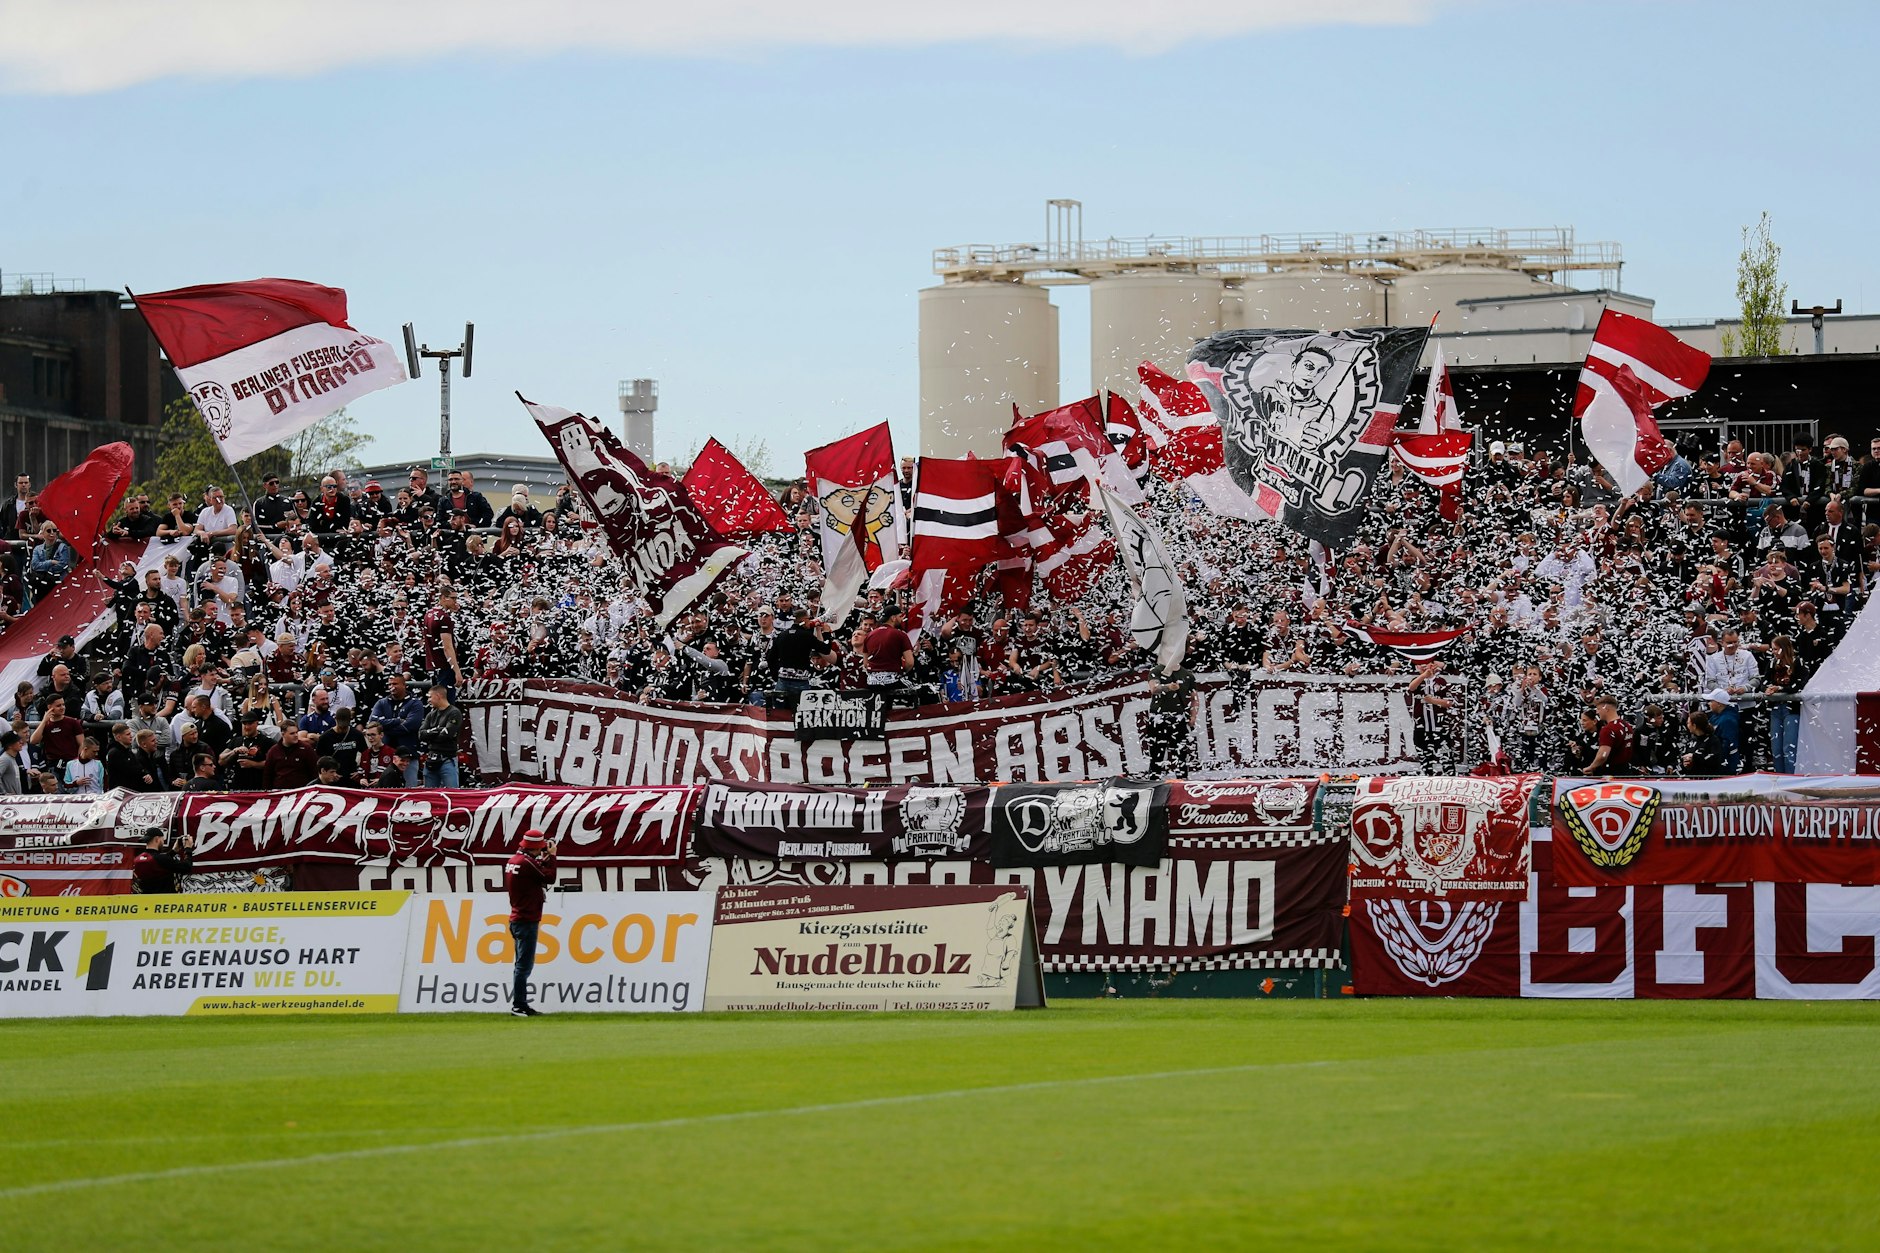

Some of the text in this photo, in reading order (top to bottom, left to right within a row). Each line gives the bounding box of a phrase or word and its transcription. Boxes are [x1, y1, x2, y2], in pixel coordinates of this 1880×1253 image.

[231, 362, 293, 400] BERLINER
[263, 349, 377, 415] DYNAMO
[795, 709, 882, 730] FRAKTION H
[0, 795, 58, 803] NAMO
[1570, 784, 1651, 810] BFC
[192, 790, 679, 855] BANDA INVICTA
[1178, 803, 1249, 825] Fanatico
[1661, 804, 1776, 840] TRADITION
[15, 835, 72, 848] BERLIN
[56, 852, 124, 864] MEISTER
[721, 889, 759, 898] Ab hier
[1352, 879, 1385, 888] BOCHUM
[1396, 879, 1426, 889] VELTEN
[154, 902, 228, 914] REPARATUR
[243, 901, 377, 912] BAUSTELLENSERVICE
[720, 911, 772, 920] Falkenberger
[830, 904, 855, 912] Berlin
[721, 902, 733, 910] 15
[734, 900, 775, 909] Minuten
[141, 926, 286, 946] WERKZEUGE,
[421, 899, 699, 964] Nascor
[798, 920, 929, 940] Kiezgaststätte
[137, 947, 361, 967] DIE GENAUSO HART
[750, 943, 972, 976] Nudelholz
[133, 971, 342, 990] ARBEITEN WIE DU.
[776, 980, 942, 991] Hausgemachte deutsche Küche
[203, 1000, 365, 1010] www.hack-werkzeughandel.de
[727, 1001, 879, 1011] www.nudelholz-berlin.com
[892, 1001, 912, 1010] Tel.
[916, 1001, 936, 1010] 030
